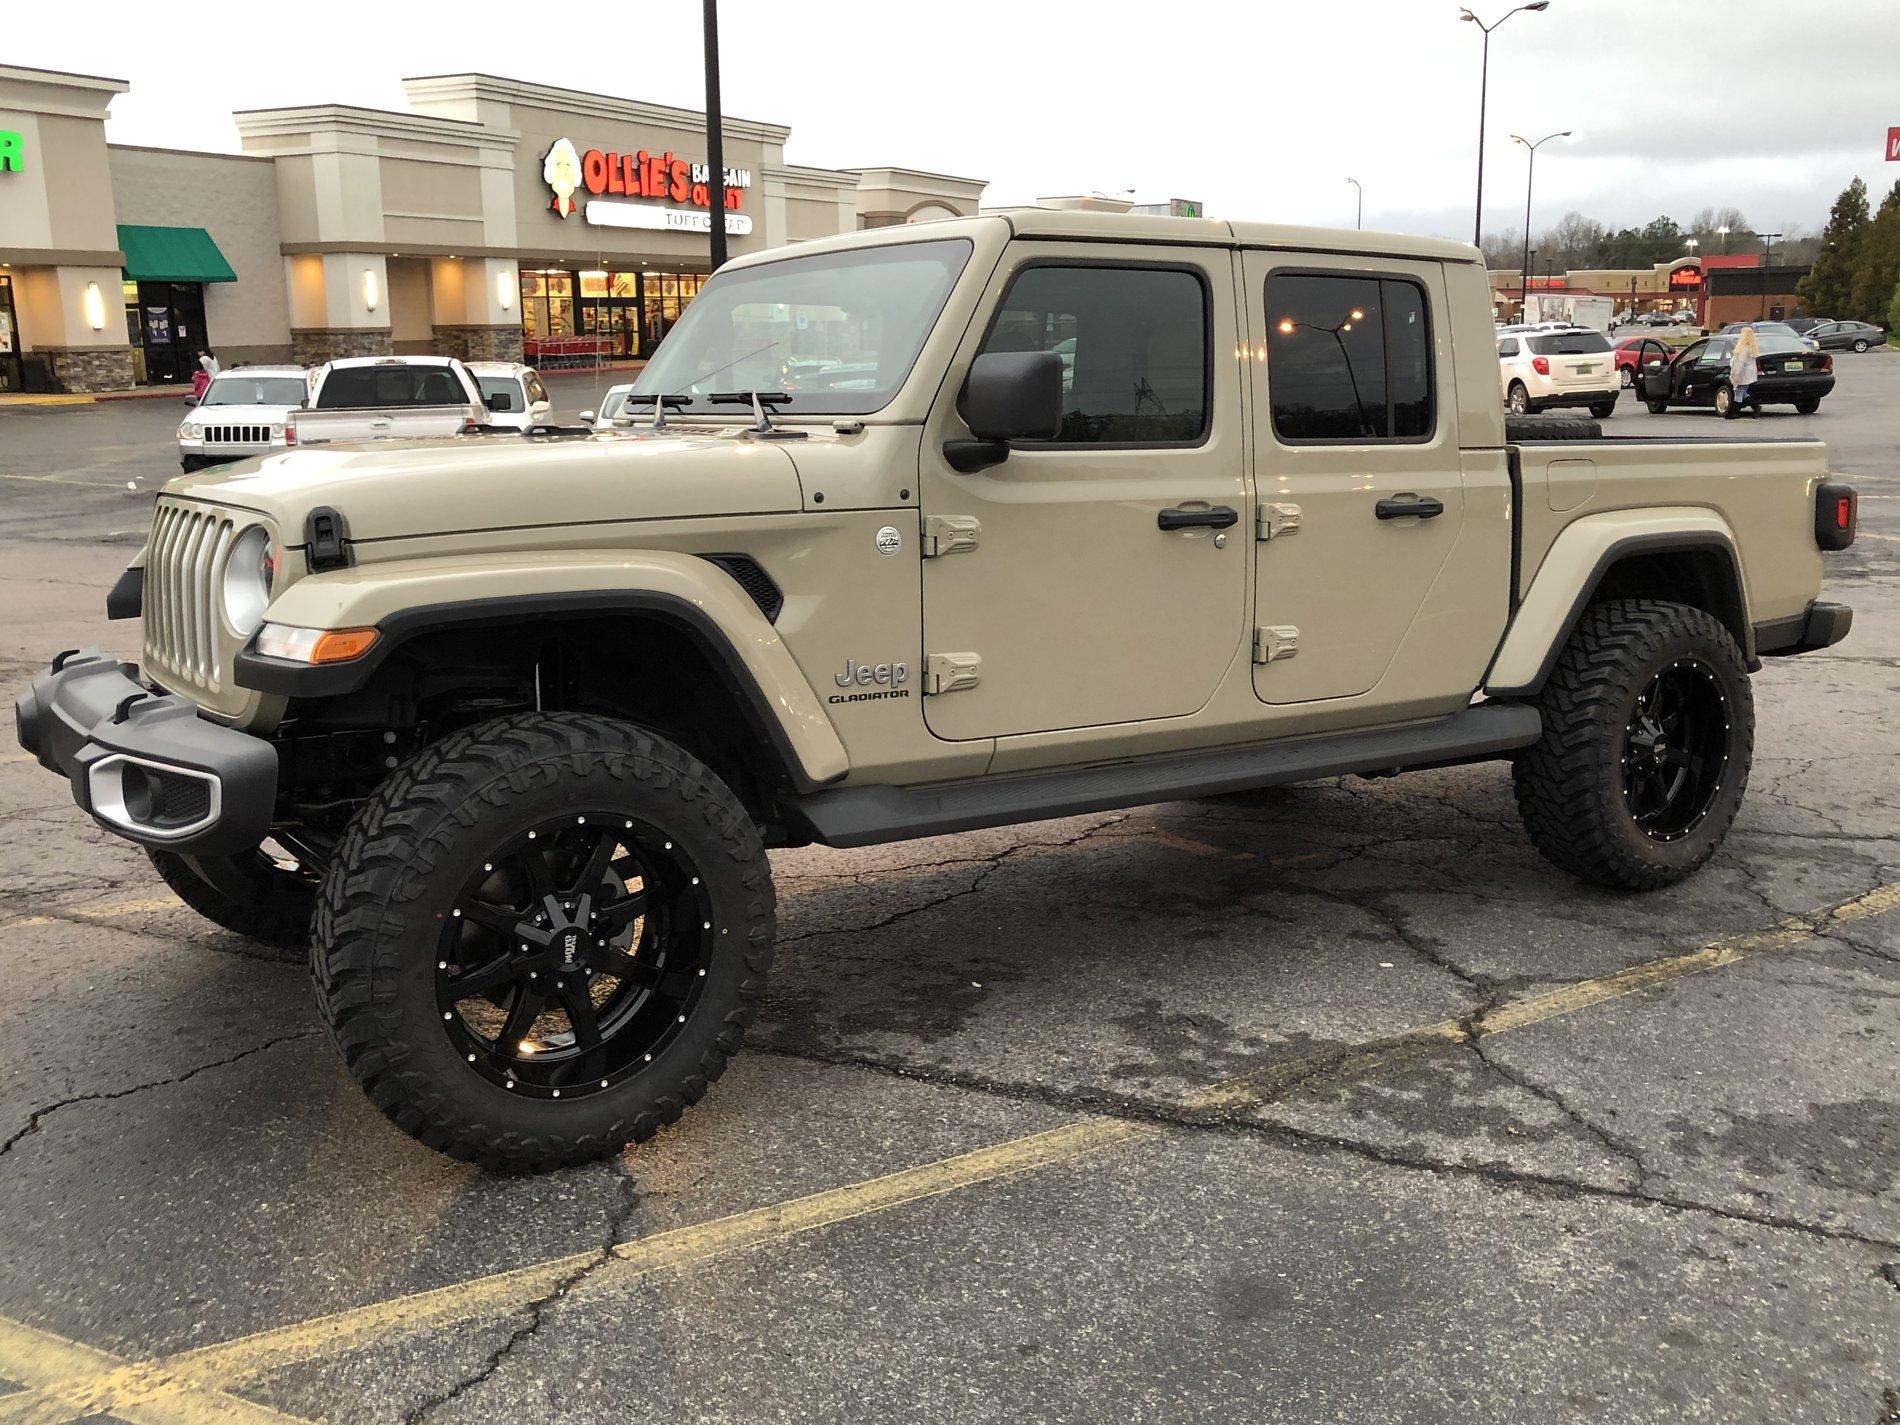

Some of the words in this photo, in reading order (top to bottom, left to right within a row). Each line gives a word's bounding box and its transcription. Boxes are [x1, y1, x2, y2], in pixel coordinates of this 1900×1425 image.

[691, 163, 750, 188] BAGAIN
[691, 184, 743, 209] OUET
[834, 659, 909, 688] Jeep
[828, 690, 909, 704] GLADIATOR
